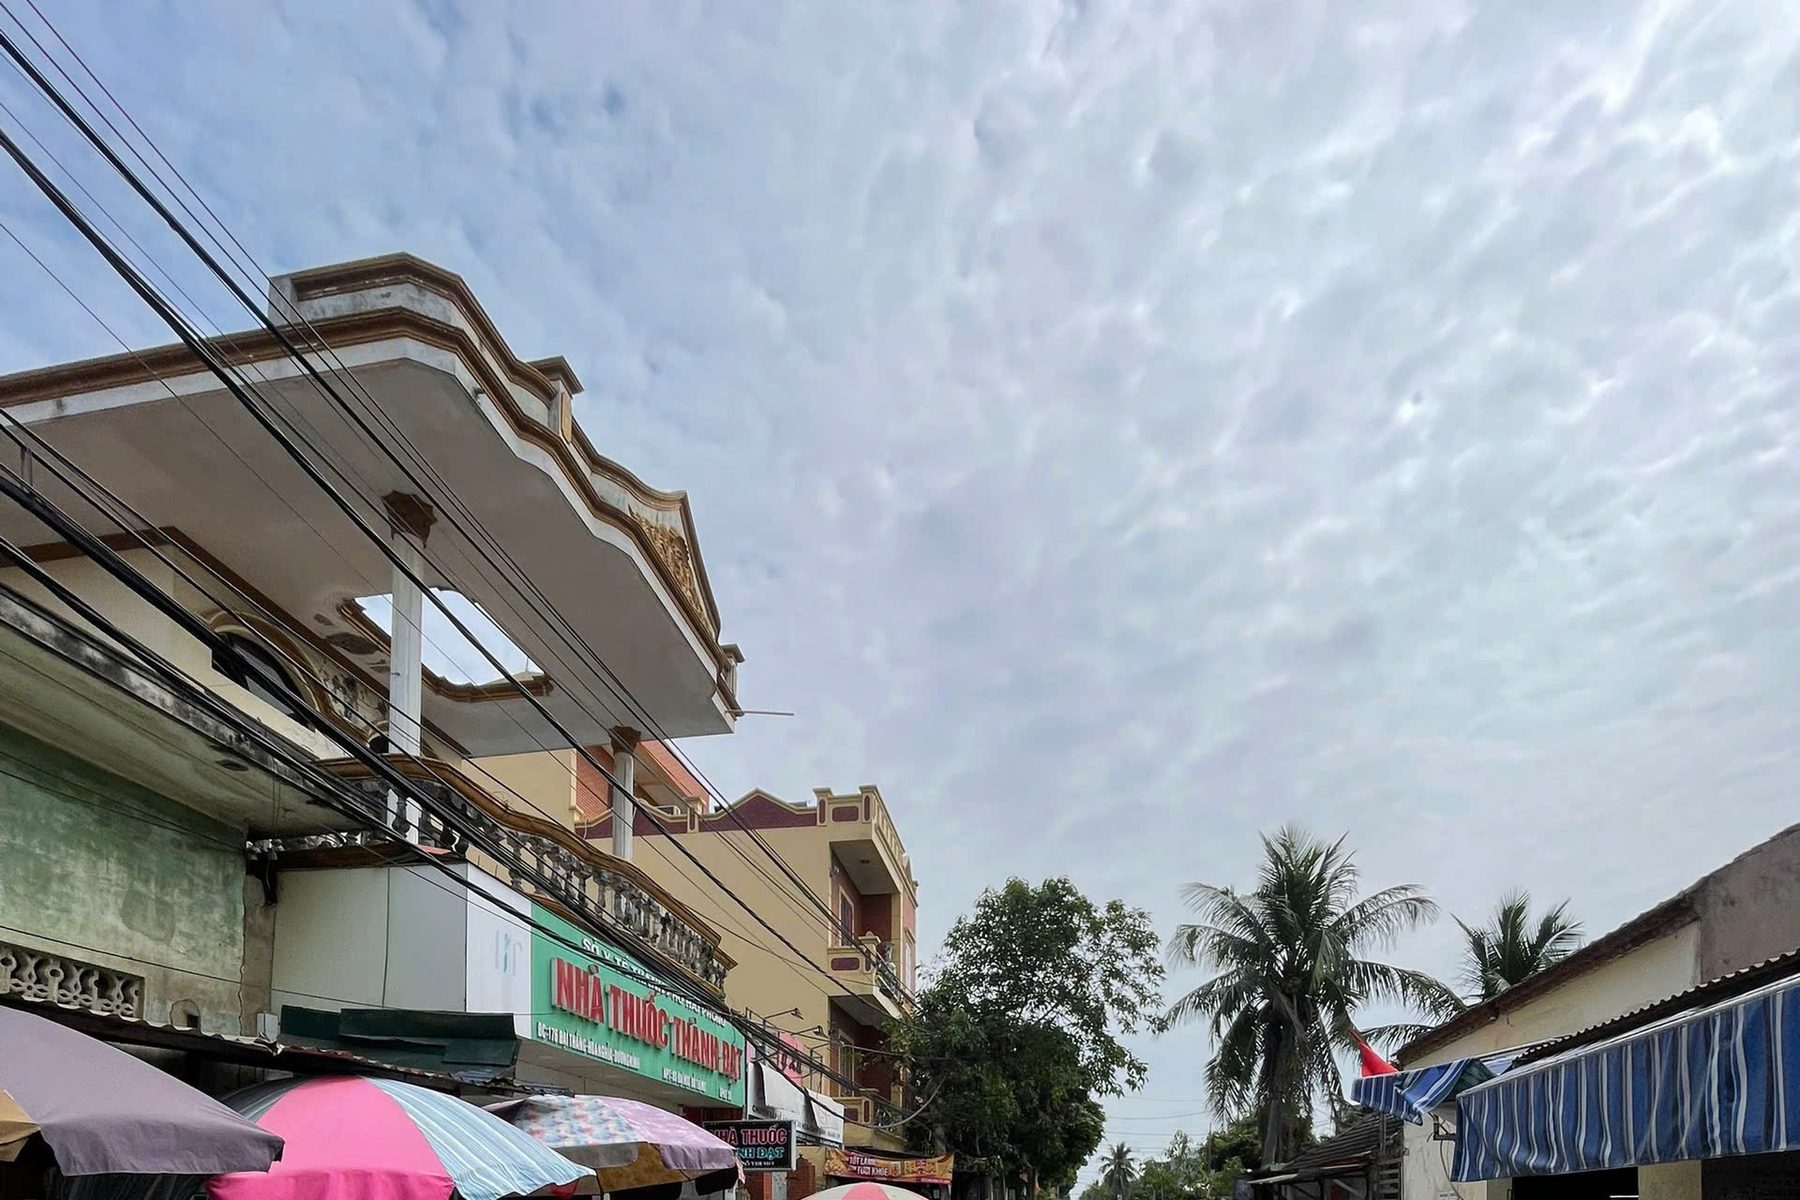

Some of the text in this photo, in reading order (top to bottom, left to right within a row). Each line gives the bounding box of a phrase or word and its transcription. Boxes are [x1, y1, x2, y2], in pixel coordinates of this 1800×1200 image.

[551, 956, 604, 1025] NHÀ
[605, 984, 670, 1051] THUỐC
[668, 1014, 719, 1072] THÀNH
[741, 1122, 788, 1145] THUỐC
[756, 1146, 785, 1160] ĐẠT
